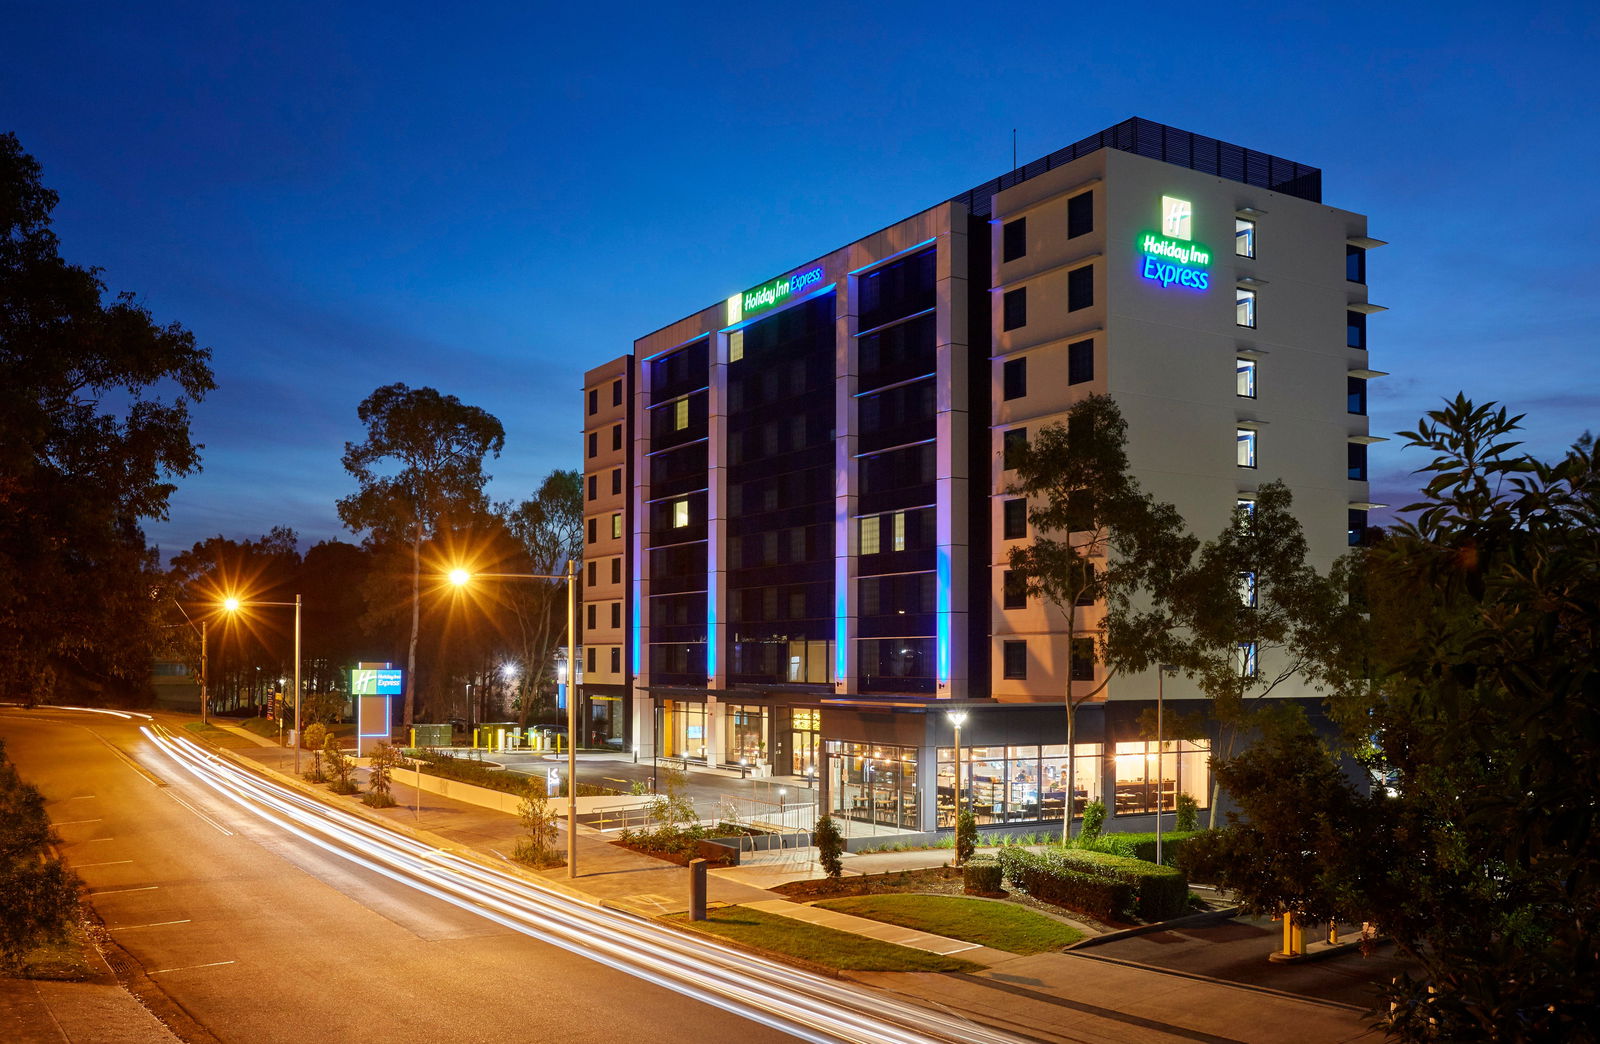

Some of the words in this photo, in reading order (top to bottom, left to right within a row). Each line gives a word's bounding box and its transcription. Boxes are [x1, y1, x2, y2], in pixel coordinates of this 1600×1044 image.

[1143, 235, 1189, 264] Holiday
[1190, 245, 1209, 265] Inn
[1143, 255, 1209, 290] Express
[745, 287, 776, 310] Holiday
[776, 281, 790, 297] Inn
[790, 268, 821, 291] Express
[378, 679, 401, 687] Express
